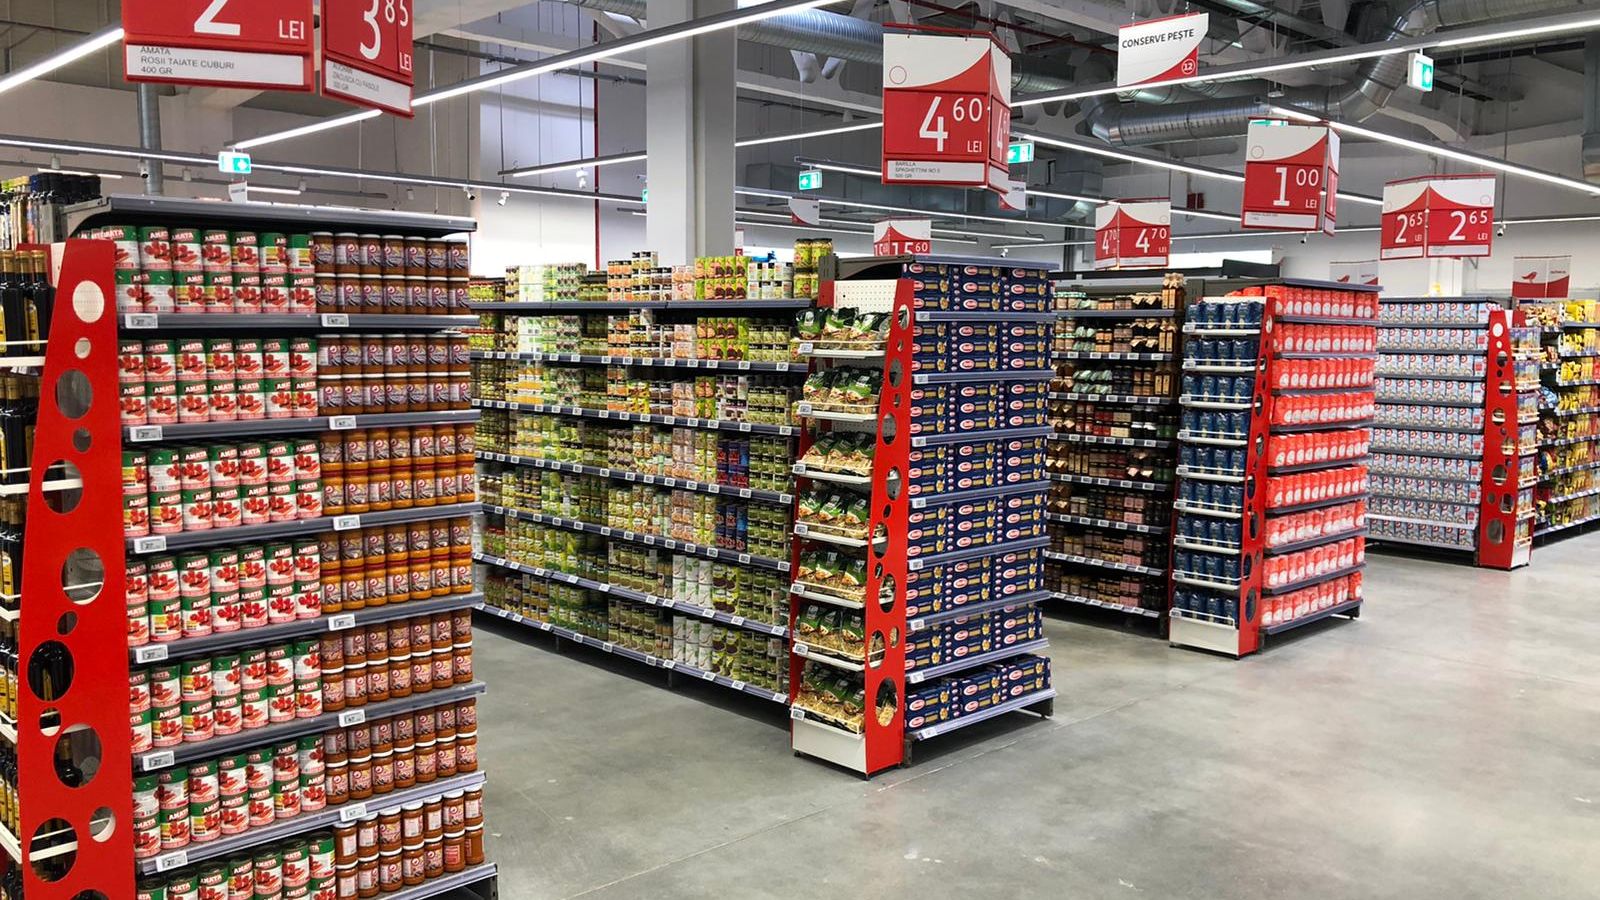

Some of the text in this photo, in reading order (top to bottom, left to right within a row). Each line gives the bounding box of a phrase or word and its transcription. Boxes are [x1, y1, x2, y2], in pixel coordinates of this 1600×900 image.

[279, 20, 304, 39] LEI
[1122, 34, 1165, 48] CONSERVE
[141, 56, 235, 69] ROSII TAIATE CUBURI
[400, 52, 412, 72] LEI
[1184, 63, 1193, 71] 12
[919, 96, 982, 152] 4 60
[967, 140, 982, 153] LEI
[1273, 167, 1319, 206] 1 00
[1306, 199, 1317, 208] LEI
[1395, 212, 1422, 243] 2 65
[1449, 210, 1488, 240] 2 65
[916, 242, 928, 252] 60
[1102, 231, 1109, 254] 4
[1136, 228, 1167, 253] 4 70
